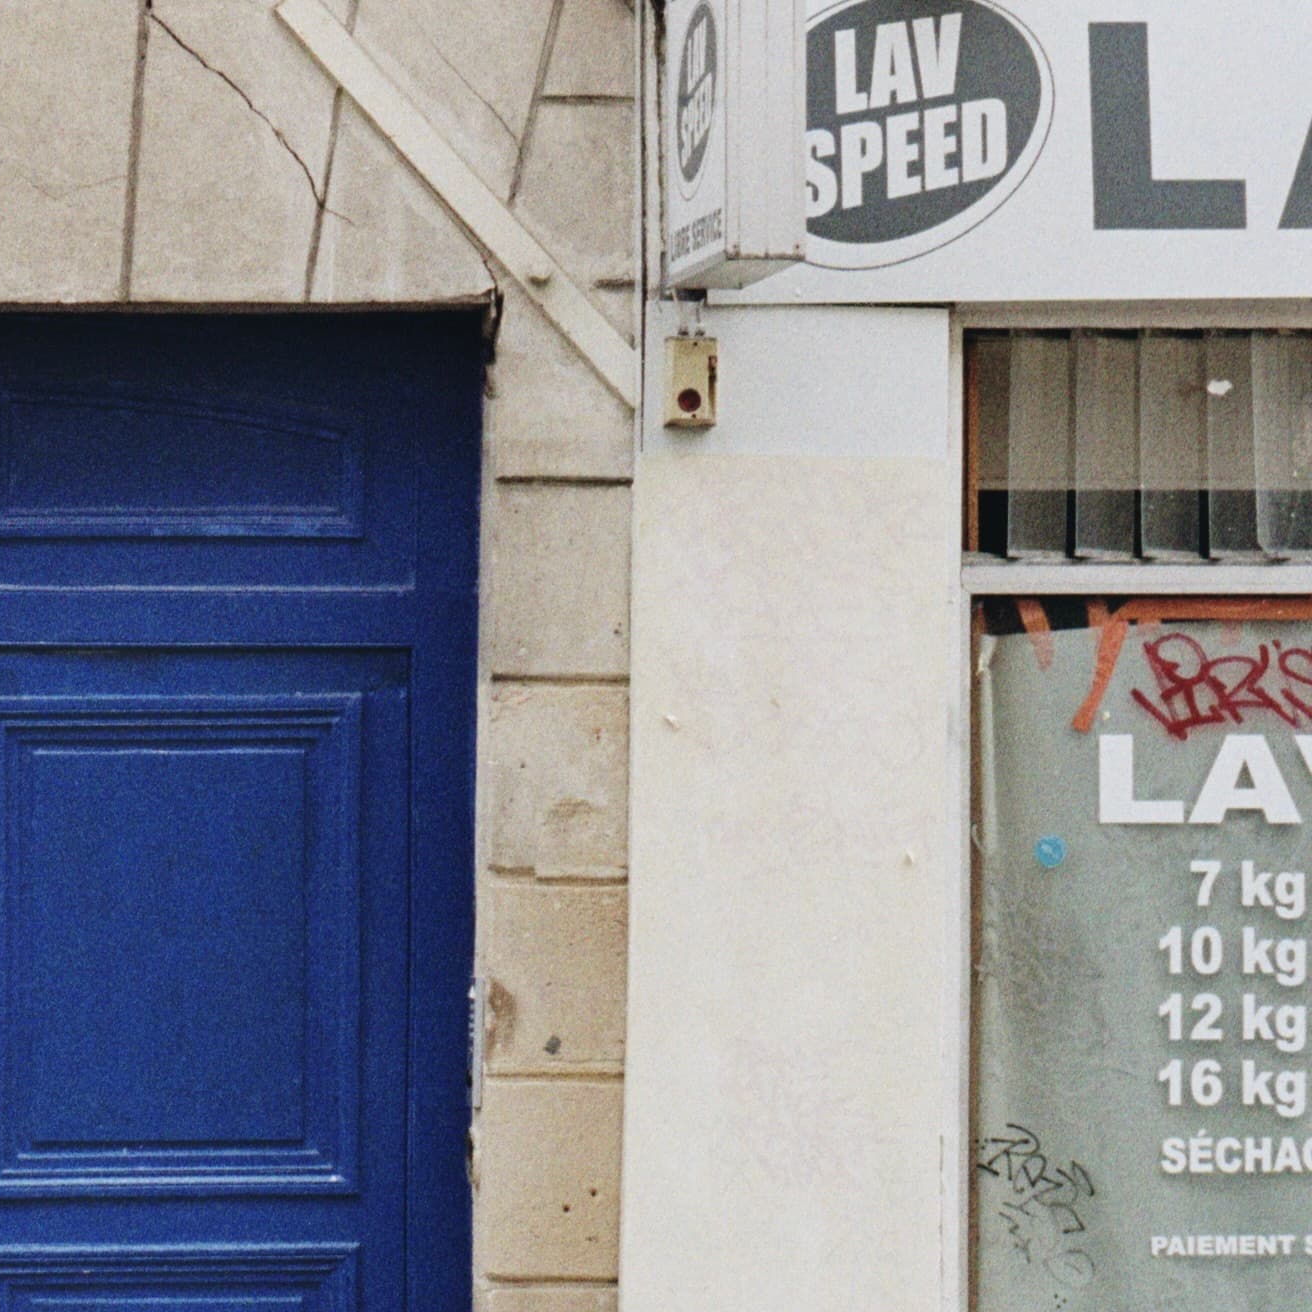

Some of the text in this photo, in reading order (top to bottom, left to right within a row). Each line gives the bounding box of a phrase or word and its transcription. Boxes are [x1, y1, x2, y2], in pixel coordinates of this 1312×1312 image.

[687, 16, 708, 95] LAV
[833, 11, 964, 116] LAV
[681, 73, 713, 169] SPEED
[1089, 21, 1312, 230] L
[806, 96, 1009, 219] SPEED
[692, 207, 722, 252] SERVICE
[1099, 733, 1312, 825] LA
[1189, 859, 1307, 920] 7 kg
[1158, 926, 1307, 987] 10 kg
[1158, 992, 1307, 1053] 12 kg
[1158, 1059, 1307, 1118] 16 kg
[1151, 1235, 1297, 1257] PAIEMENT
